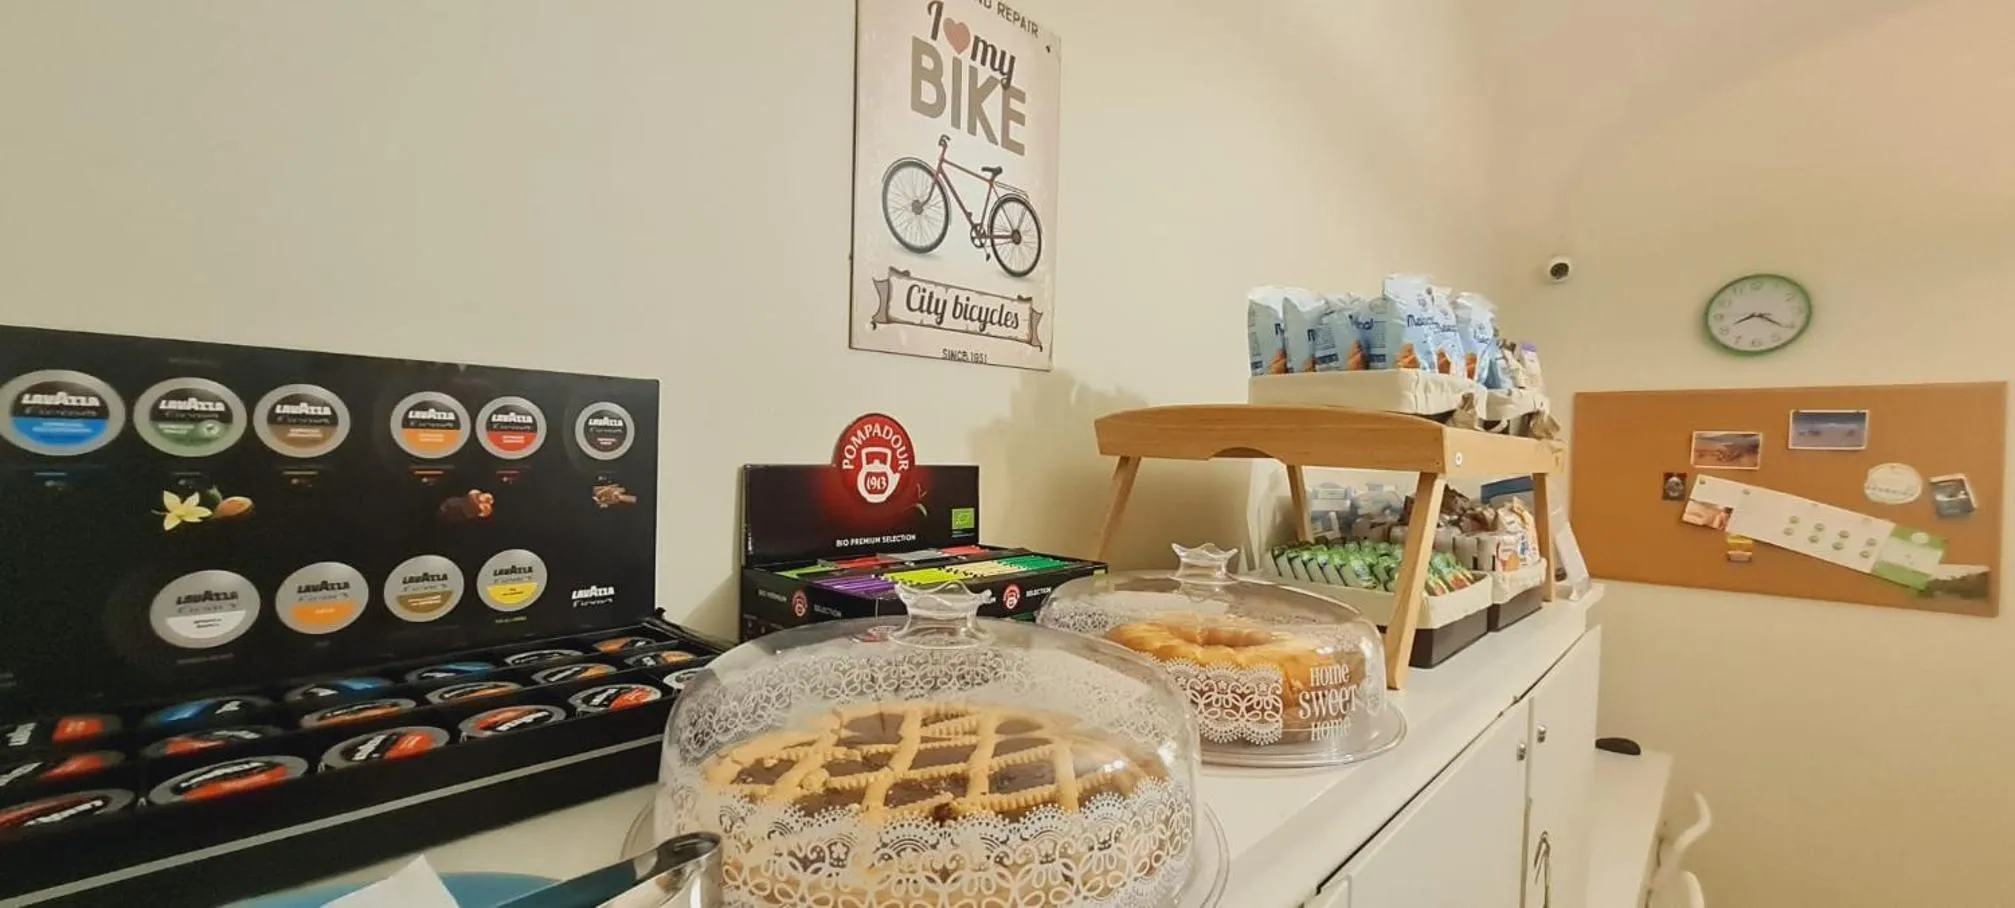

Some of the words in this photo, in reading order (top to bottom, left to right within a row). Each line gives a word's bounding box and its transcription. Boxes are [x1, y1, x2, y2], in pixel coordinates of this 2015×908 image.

[997, 1, 1039, 39] REPAIR
[927, 0, 944, 41] I
[970, 35, 1016, 91] my
[911, 35, 1026, 156] BIKE
[906, 284, 948, 325] City
[952, 294, 1019, 332] bicycles
[842, 423, 911, 471] POMPADOUR
[866, 475, 887, 490] 1913
[850, 536, 880, 546] PREMIUM
[882, 534, 916, 544] SELECTION
